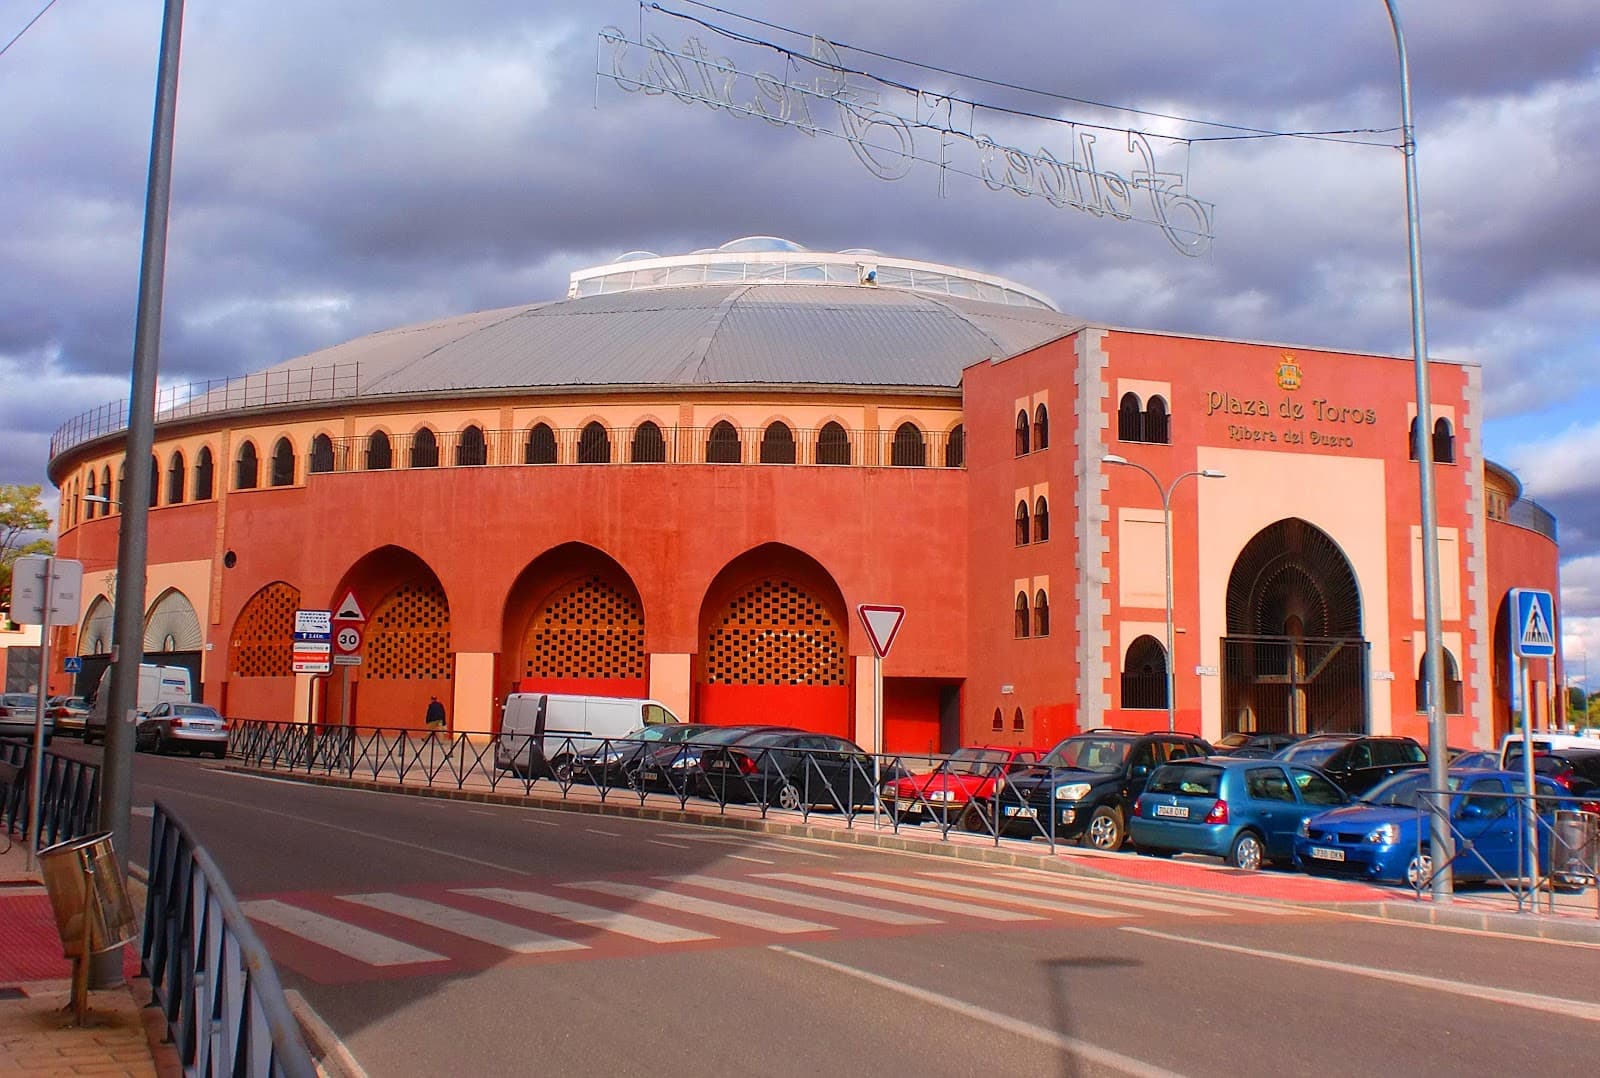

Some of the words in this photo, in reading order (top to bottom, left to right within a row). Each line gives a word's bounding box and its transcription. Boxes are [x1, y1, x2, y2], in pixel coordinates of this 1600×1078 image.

[1207, 391, 1270, 417] Plaza
[1278, 397, 1305, 421] de
[1312, 399, 1377, 425] Toros
[1228, 425, 1278, 442] Ribera
[1283, 429, 1304, 445] del
[1310, 431, 1354, 448] Duero
[340, 634, 357, 645] 30
